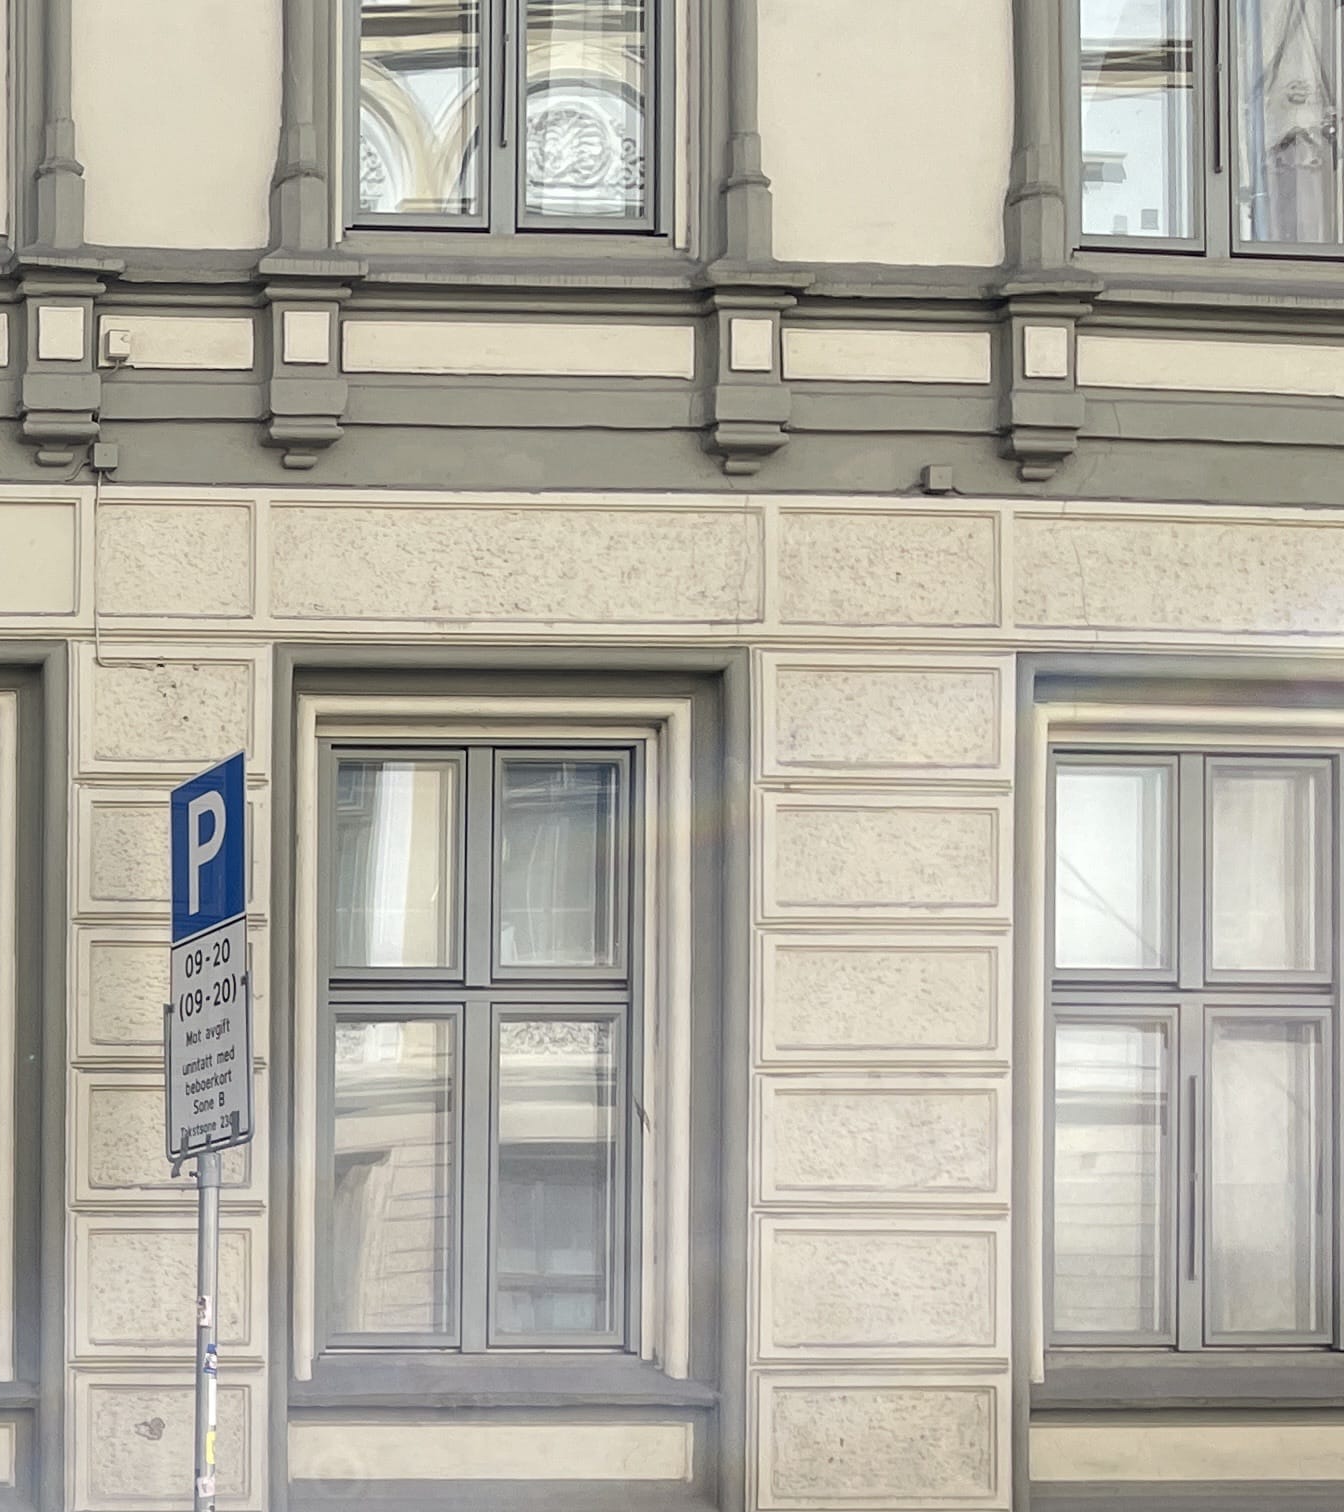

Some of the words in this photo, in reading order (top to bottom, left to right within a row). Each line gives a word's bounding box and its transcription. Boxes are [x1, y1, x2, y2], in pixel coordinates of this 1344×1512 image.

[188, 790, 227, 916] P
[179, 973, 237, 1022] (09-20)
[185, 1030, 202, 1047] Mot
[205, 1018, 230, 1040] avgift
[182, 1054, 213, 1076] unntatt
[216, 1045, 235, 1064] med
[185, 1069, 232, 1096] beboerkort
[193, 1097, 214, 1115] Sone
[218, 1091, 225, 1107] B
